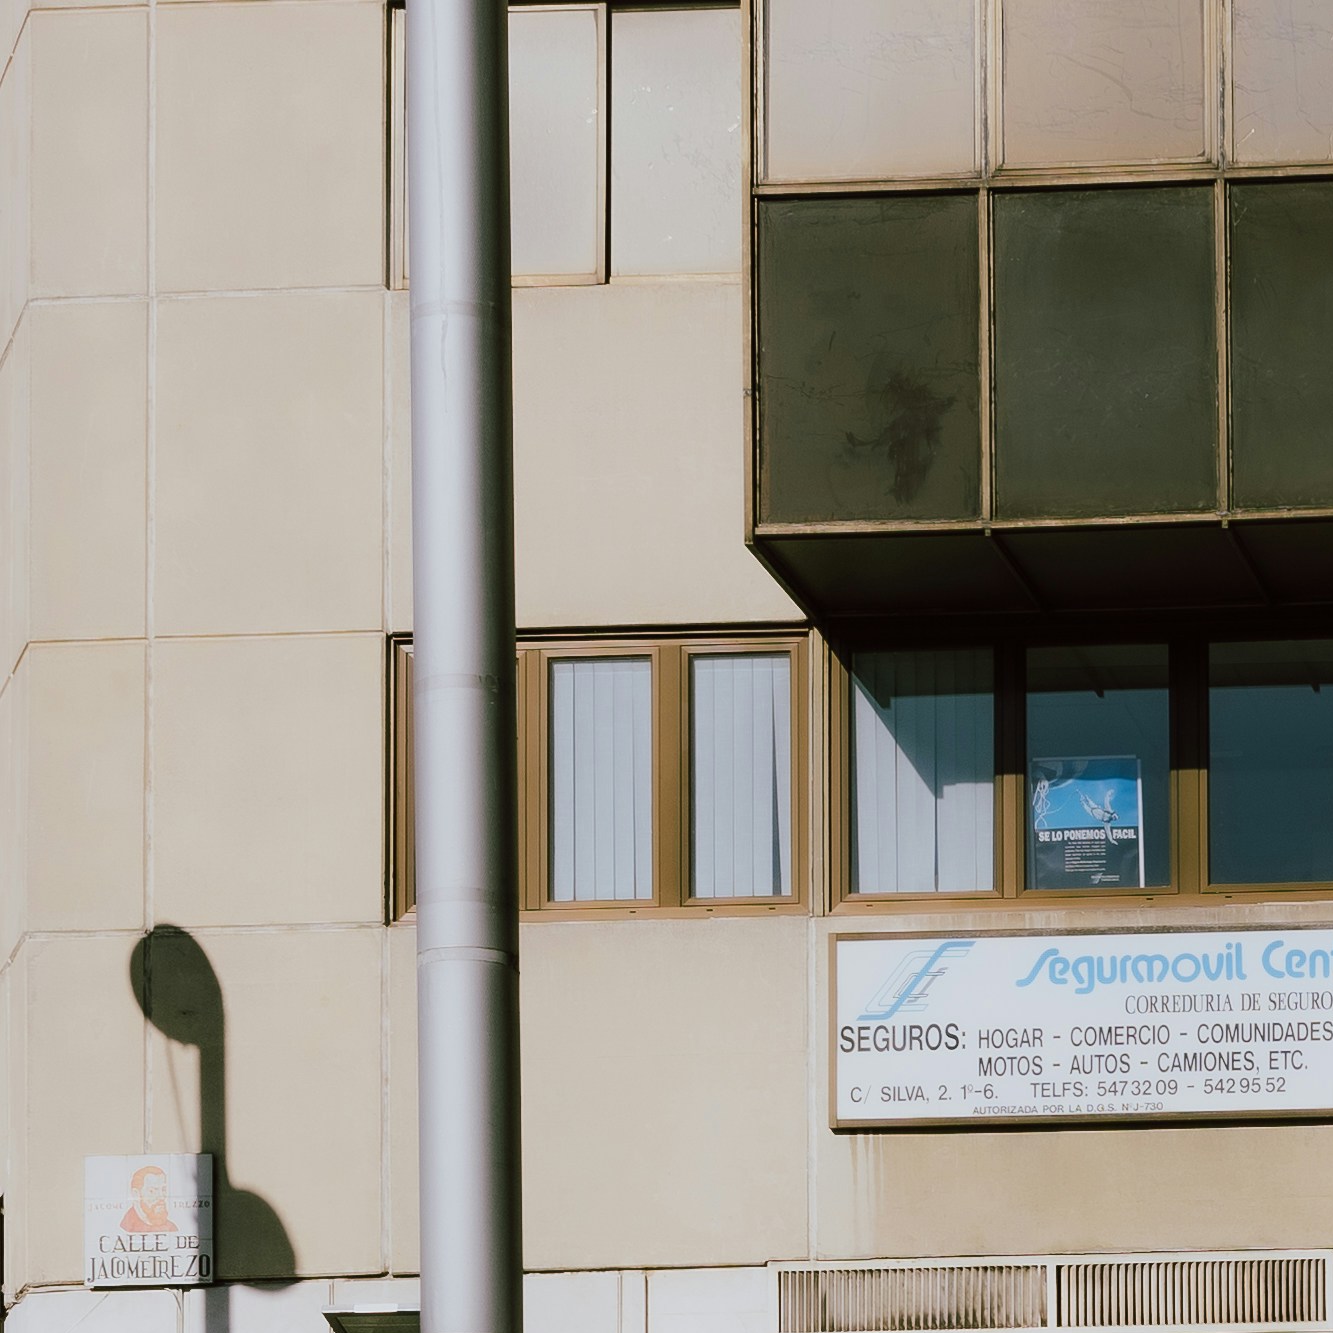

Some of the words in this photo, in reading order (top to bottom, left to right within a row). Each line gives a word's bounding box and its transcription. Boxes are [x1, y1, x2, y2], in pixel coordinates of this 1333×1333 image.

[1039, 831, 1050, 842] SE
[1052, 831, 1062, 841] LO
[1064, 829, 1106, 840] PONEMOS
[1112, 829, 1137, 839] FACIL
[1015, 942, 1248, 995] Segurmovil
[1125, 992, 1233, 1015] CORREDURIA
[1241, 993, 1261, 1012] DE
[840, 1022, 967, 1053] SEGUROS:
[978, 1028, 1044, 1050] HOGAR
[1070, 1024, 1170, 1046] COMERCIO
[1197, 1020, 1333, 1044] COMUNIDADES
[978, 1055, 1043, 1077] MOTOS
[1070, 1053, 1131, 1075] AUTOS
[1157, 1050, 1260, 1074] CAMIONES,
[1269, 1050, 1309, 1070] ETC.
[850, 1084, 872, 1105] C/
[881, 1085, 930, 1105] SILVA,
[1030, 1081, 1088, 1099] TELFS:
[972, 1104, 1039, 1115] AUTORIZADA
[1042, 1104, 1064, 1113] POR
[1069, 1104, 1082, 1113] LA
[99, 1234, 169, 1253] CALLE
[175, 1235, 200, 1249] DE
[87, 1253, 211, 1283] JACOMETREZO
